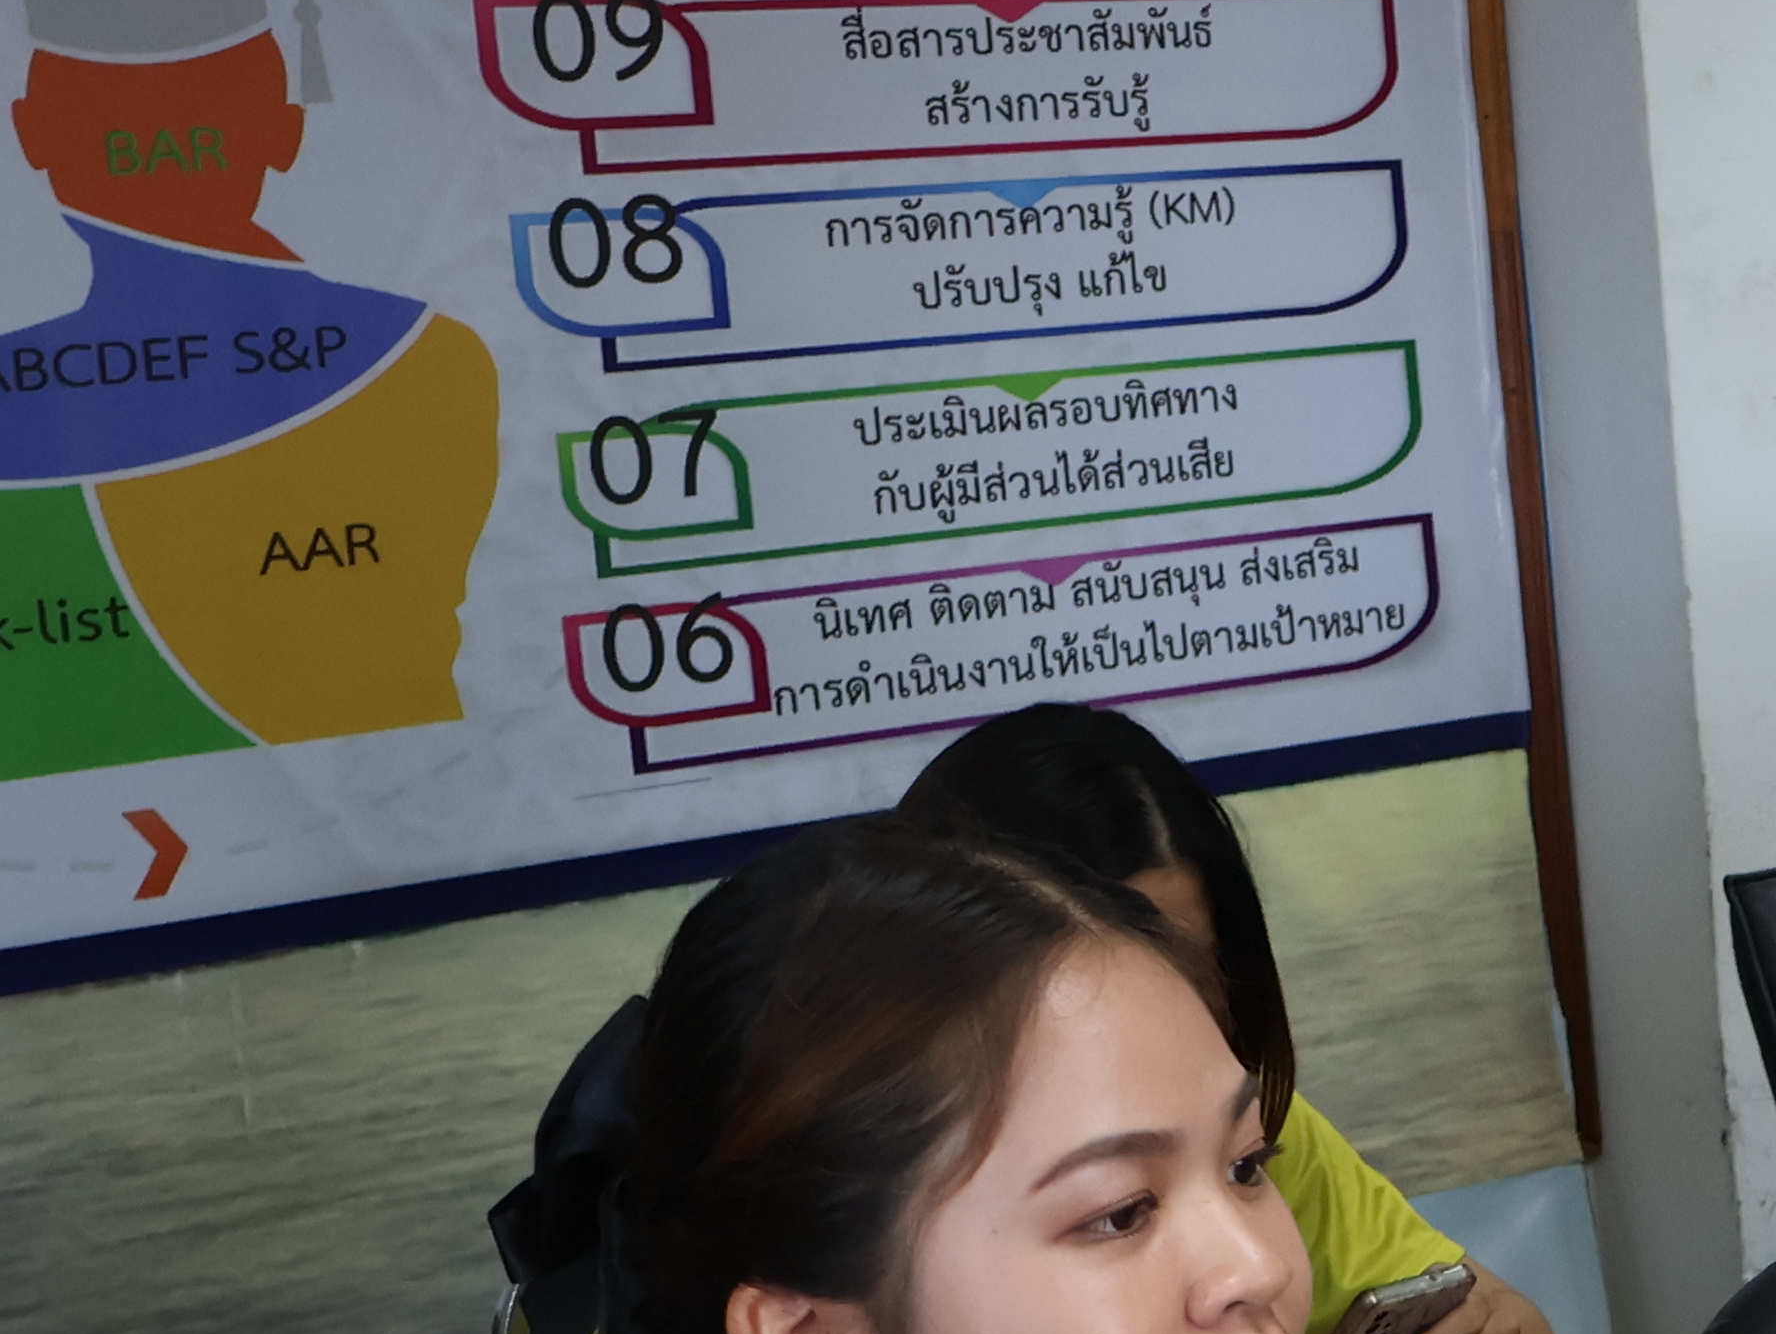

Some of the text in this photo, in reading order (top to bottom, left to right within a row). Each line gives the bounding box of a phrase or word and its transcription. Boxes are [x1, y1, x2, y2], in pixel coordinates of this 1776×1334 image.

[840, 2, 1214, 63] สื่อสารประชาสัมพันธ์
[924, 74, 1153, 135] สร้างการรับรู้
[105, 126, 230, 176] BAR
[547, 194, 684, 289] 08
[824, 187, 1237, 251] การจัดการความรู้ (KM)
[912, 247, 1168, 320] ปรับปรุง แก้ไข
[234, 325, 348, 377] S&P
[853, 378, 1240, 447] ประเมินผลรอบทิศทาง
[588, 408, 718, 506] 07
[872, 436, 1236, 524] กับผู้มีส่วนได้ส่วนเสีย
[259, 522, 381, 576] AAR
[812, 535, 1360, 642] นิเทศ ติดตาม สนับสนุน ส่งเสริม
[602, 592, 735, 694] 06
[772, 600, 1406, 717] การดำเนินงานให้เป็นไปตามเป้าหมาย
